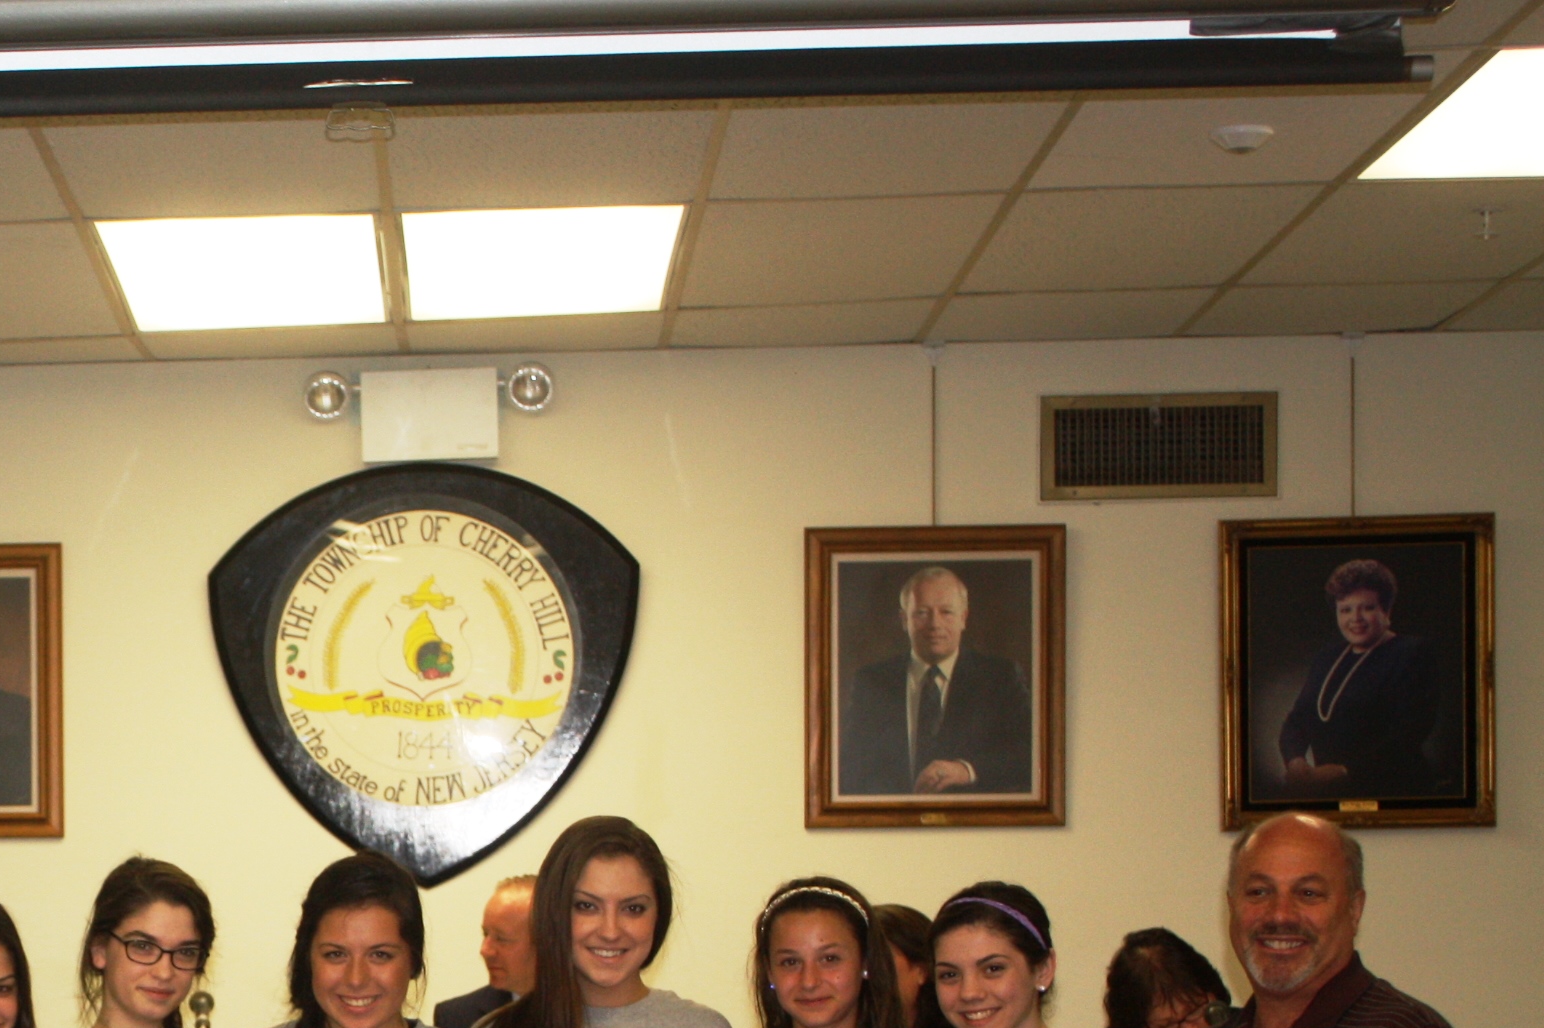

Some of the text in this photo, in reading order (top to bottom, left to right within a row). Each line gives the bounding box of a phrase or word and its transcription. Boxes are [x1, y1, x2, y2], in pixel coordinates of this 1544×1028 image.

[281, 514, 570, 651] THE TOWNSHIP OF CHERRY HILL
[290, 708, 310, 731] in
[304, 727, 329, 760] the
[383, 778, 408, 803] of
[415, 771, 467, 805] NEW
[473, 717, 547, 795] JERSEY
[396, 730, 454, 760] 1844
